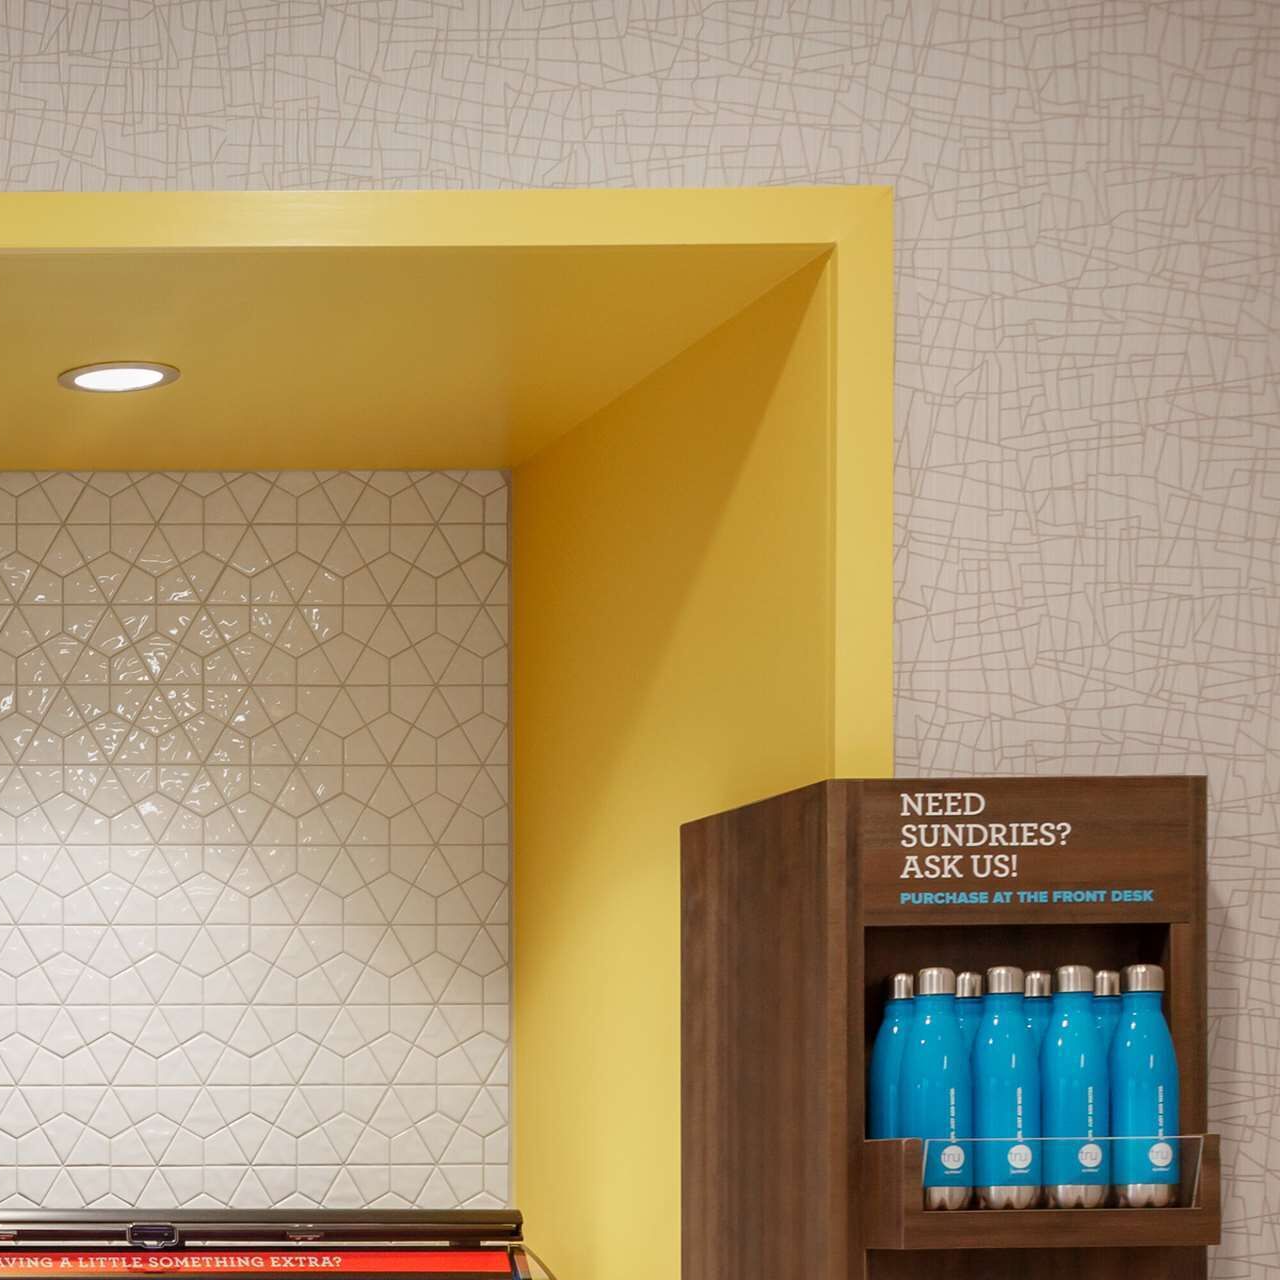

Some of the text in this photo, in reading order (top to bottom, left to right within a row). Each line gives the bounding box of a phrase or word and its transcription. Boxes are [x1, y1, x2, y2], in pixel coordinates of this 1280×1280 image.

[900, 793, 986, 816] NEED
[900, 822, 1072, 848] SUNDRIES?
[900, 854, 1018, 879] ASK US!
[900, 889, 1153, 905] PURCHASE AT THE FRONT DESK
[60, 1257, 72, 1268] A
[78, 1257, 143, 1269] LITTLE
[148, 1256, 265, 1268] SOMETHING
[271, 1256, 343, 1268] EXTRA?
